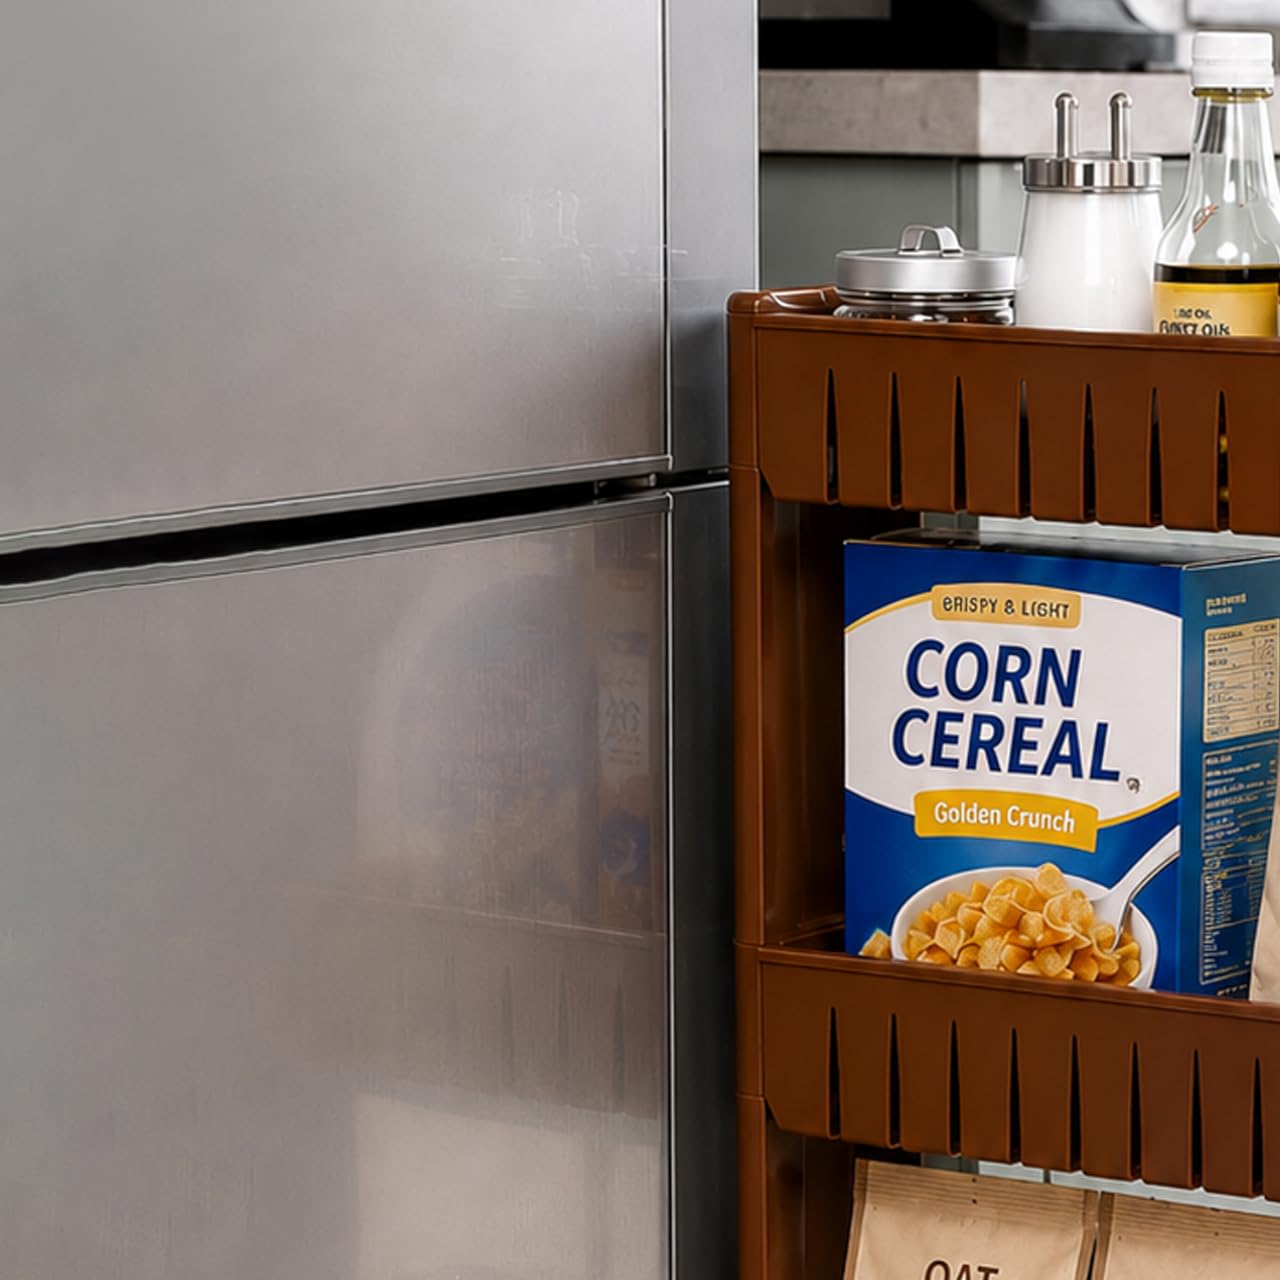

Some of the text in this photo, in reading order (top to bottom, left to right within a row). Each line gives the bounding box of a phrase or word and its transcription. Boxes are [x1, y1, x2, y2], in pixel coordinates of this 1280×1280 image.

[1004, 599, 1015, 615] &
[1022, 600, 1070, 618] LIGHT
[906, 639, 1082, 708] CORN
[892, 708, 1121, 782] CEREAL
[934, 801, 1075, 833] Golden Crunch
